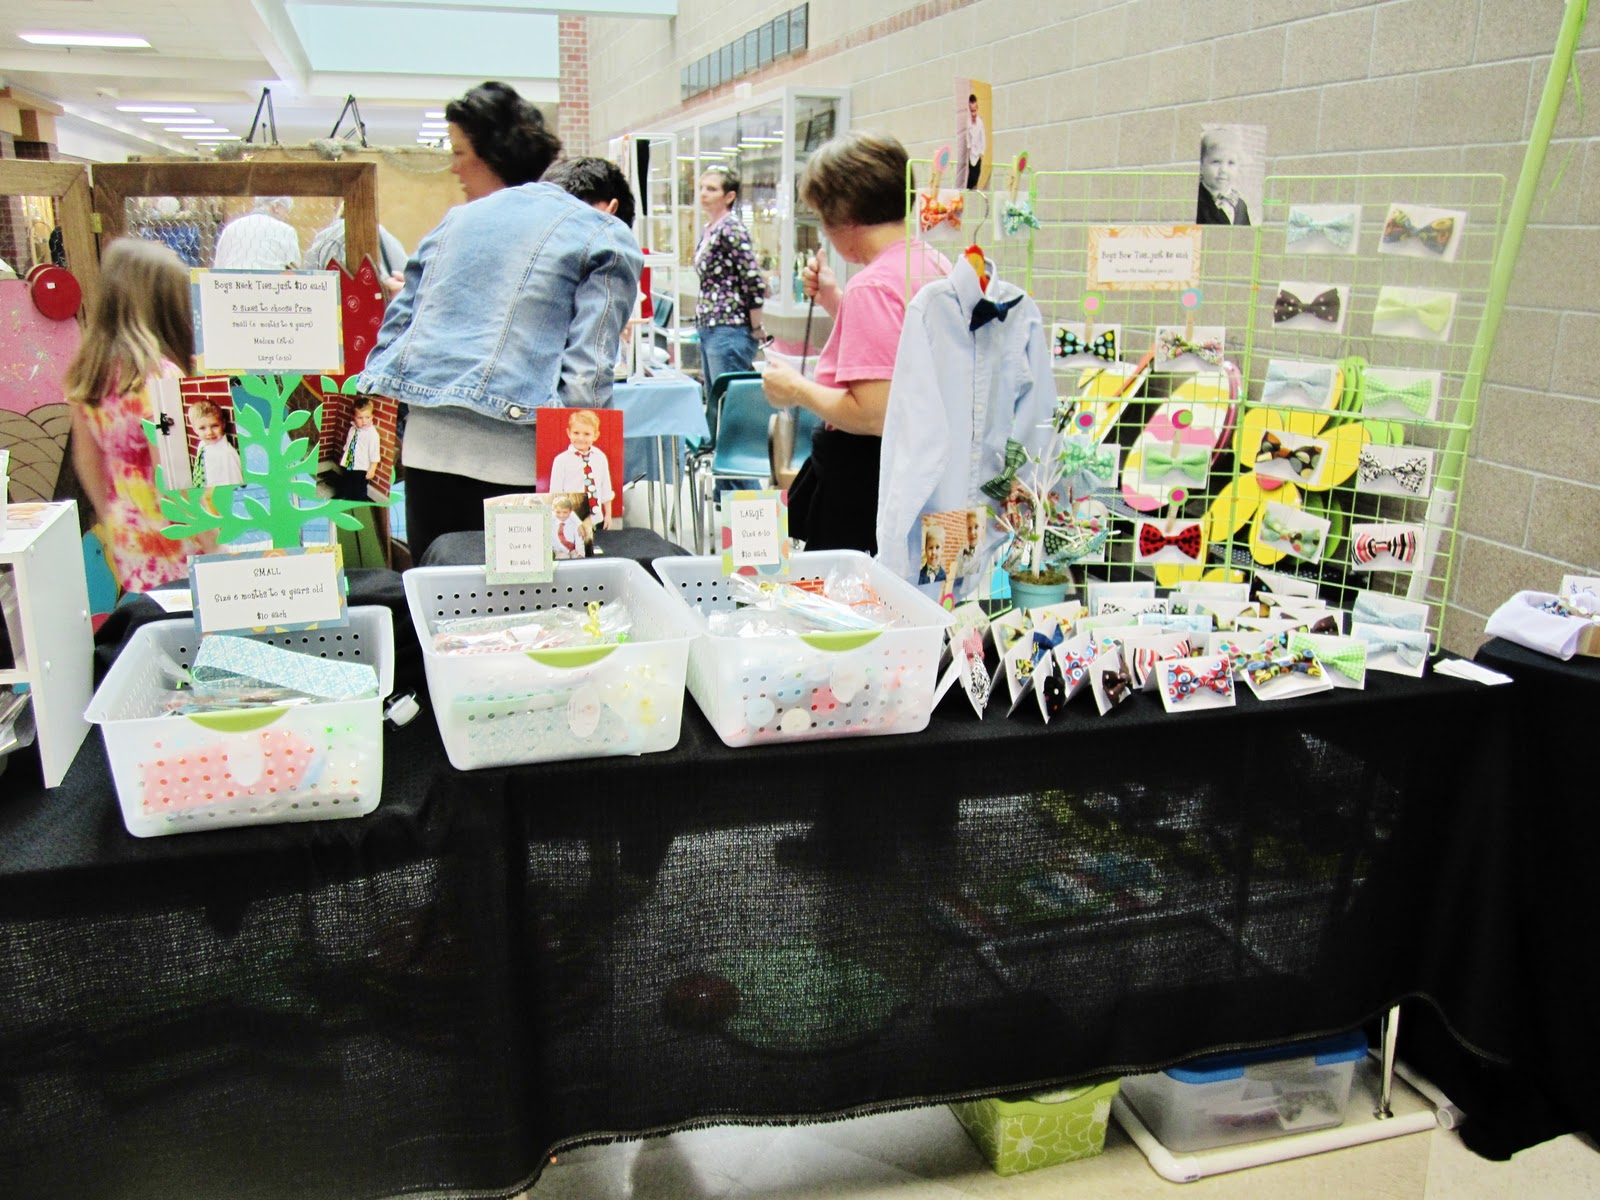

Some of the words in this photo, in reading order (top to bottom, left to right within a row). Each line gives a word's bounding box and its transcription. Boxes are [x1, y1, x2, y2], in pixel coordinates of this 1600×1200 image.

[214, 280, 232, 294] Boys
[236, 280, 253, 290] Neck
[294, 280, 307, 290] $10
[310, 281, 328, 290] each!
[240, 304, 258, 312] sizes
[258, 302, 268, 312] to
[270, 304, 292, 312] choose
[294, 303, 312, 312] from
[260, 320, 280, 328] months
[280, 320, 288, 328] to
[740, 508, 764, 520] LARGE
[742, 530, 756, 538] Size
[742, 550, 752, 558] $10
[754, 549, 767, 557] each
[253, 568, 281, 577] SMALL
[214, 594, 231, 602] Size
[241, 589, 268, 600] months
[269, 587, 278, 597] to
[289, 587, 310, 600] years
[312, 584, 324, 593] old
[256, 612, 268, 620] $10
[271, 609, 287, 618] each
